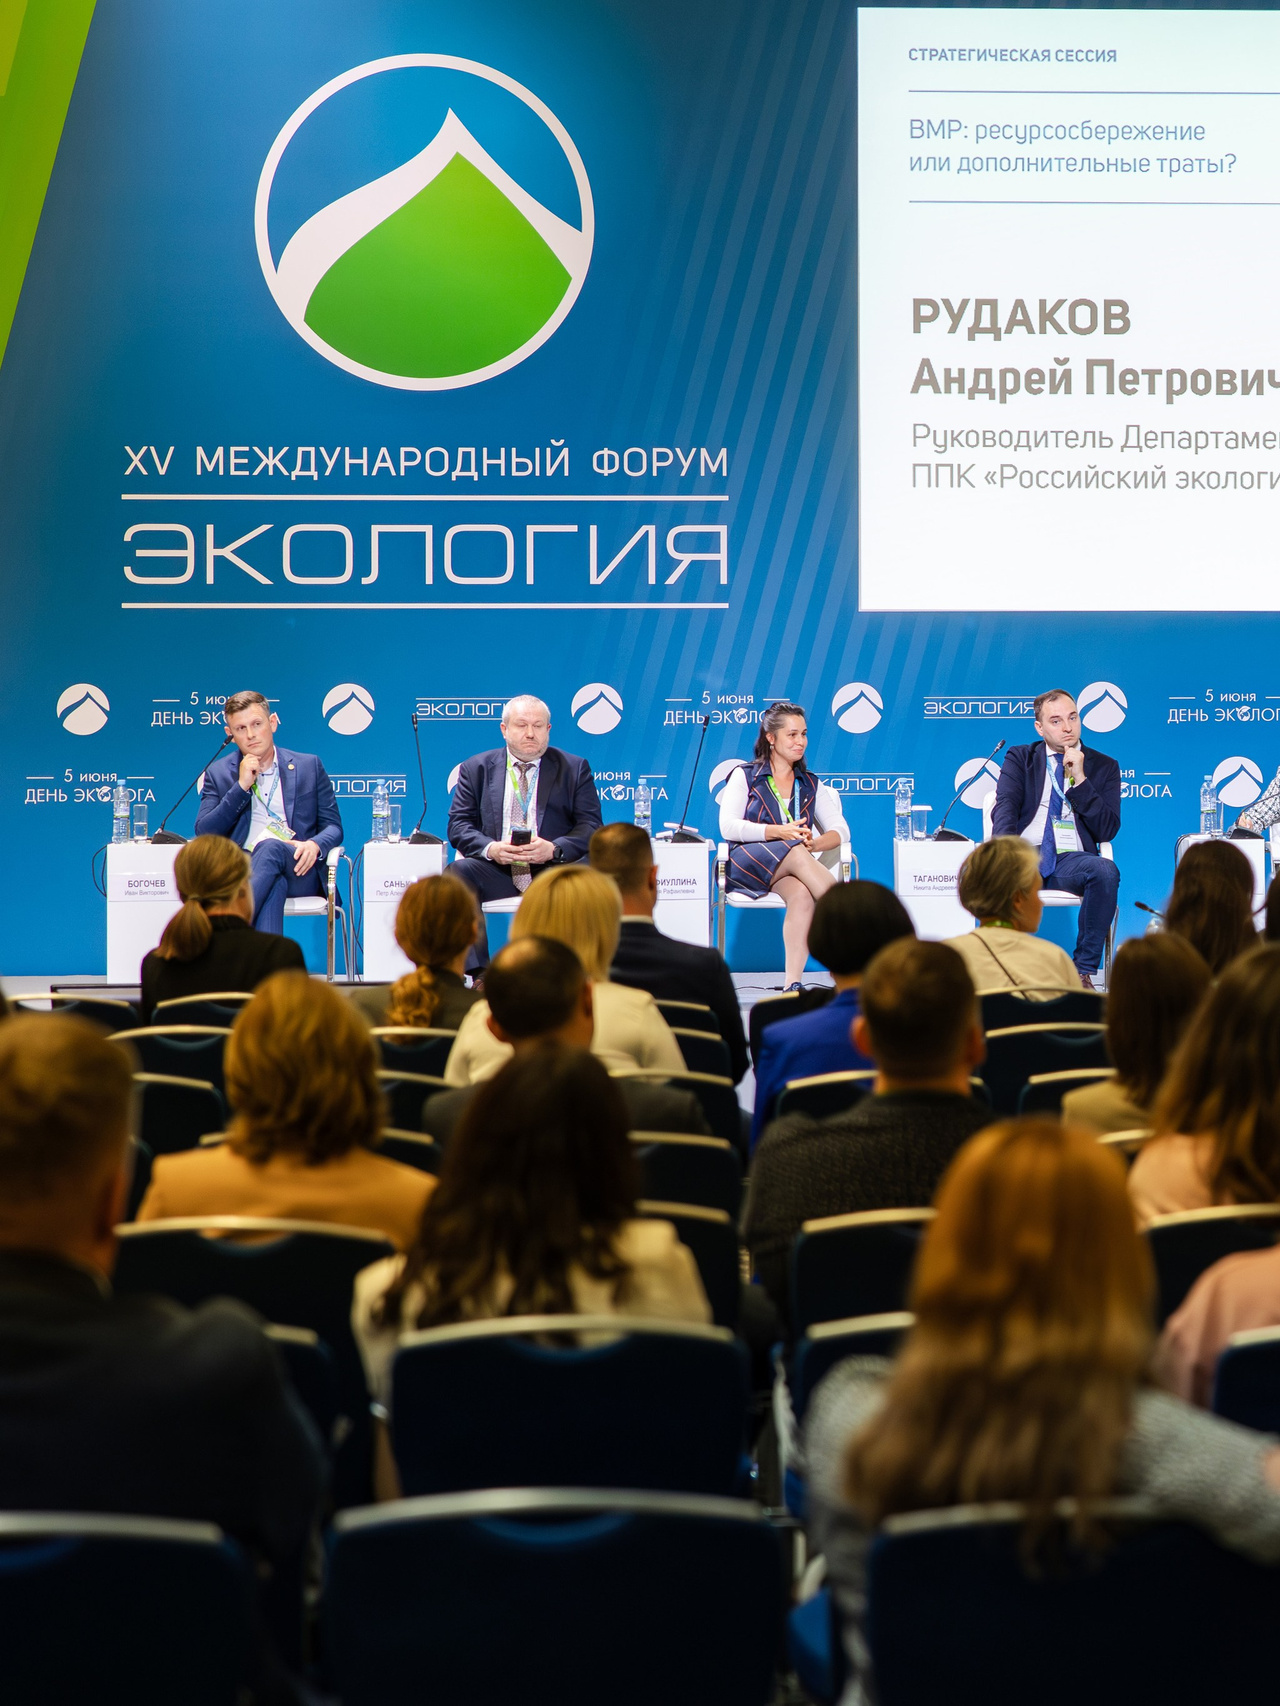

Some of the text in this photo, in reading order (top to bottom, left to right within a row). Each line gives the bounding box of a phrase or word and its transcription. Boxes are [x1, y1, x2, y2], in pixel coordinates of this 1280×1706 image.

[909, 48, 1116, 62] СТРАТЕГИЧЕСКАЯ СЕССИЯ
[909, 119, 1205, 144] ВМР: ресурсосбережение
[910, 154, 1236, 177] или дополнительные траты?
[913, 298, 1130, 341] РУДАКОВ
[910, 357, 1072, 404] Андрей
[913, 424, 1113, 454] Руководитель
[125, 440, 728, 480] XV МЕЖДУНАРОДНЫЙ ФОРУМ
[913, 464, 975, 488] ППК
[985, 464, 1165, 489] «Российский
[124, 524, 727, 584] ЭКОЛОГИЯ
[190, 692, 226, 705] 5 ию
[702, 691, 753, 704] 5 июня
[1206, 689, 1255, 702] 5 июня
[416, 703, 506, 716] ЭКОЛОГ
[923, 702, 1034, 715] ЭКОЛОГИЯ
[1168, 709, 1208, 723] ДЕНЬ
[151, 712, 193, 727] ДЕНЬ
[663, 708, 765, 726] ДЕНЬ ЭКОЛО
[64, 769, 117, 782] 5 июня
[594, 771, 631, 781] июня
[25, 789, 67, 804] ДЕНЬ
